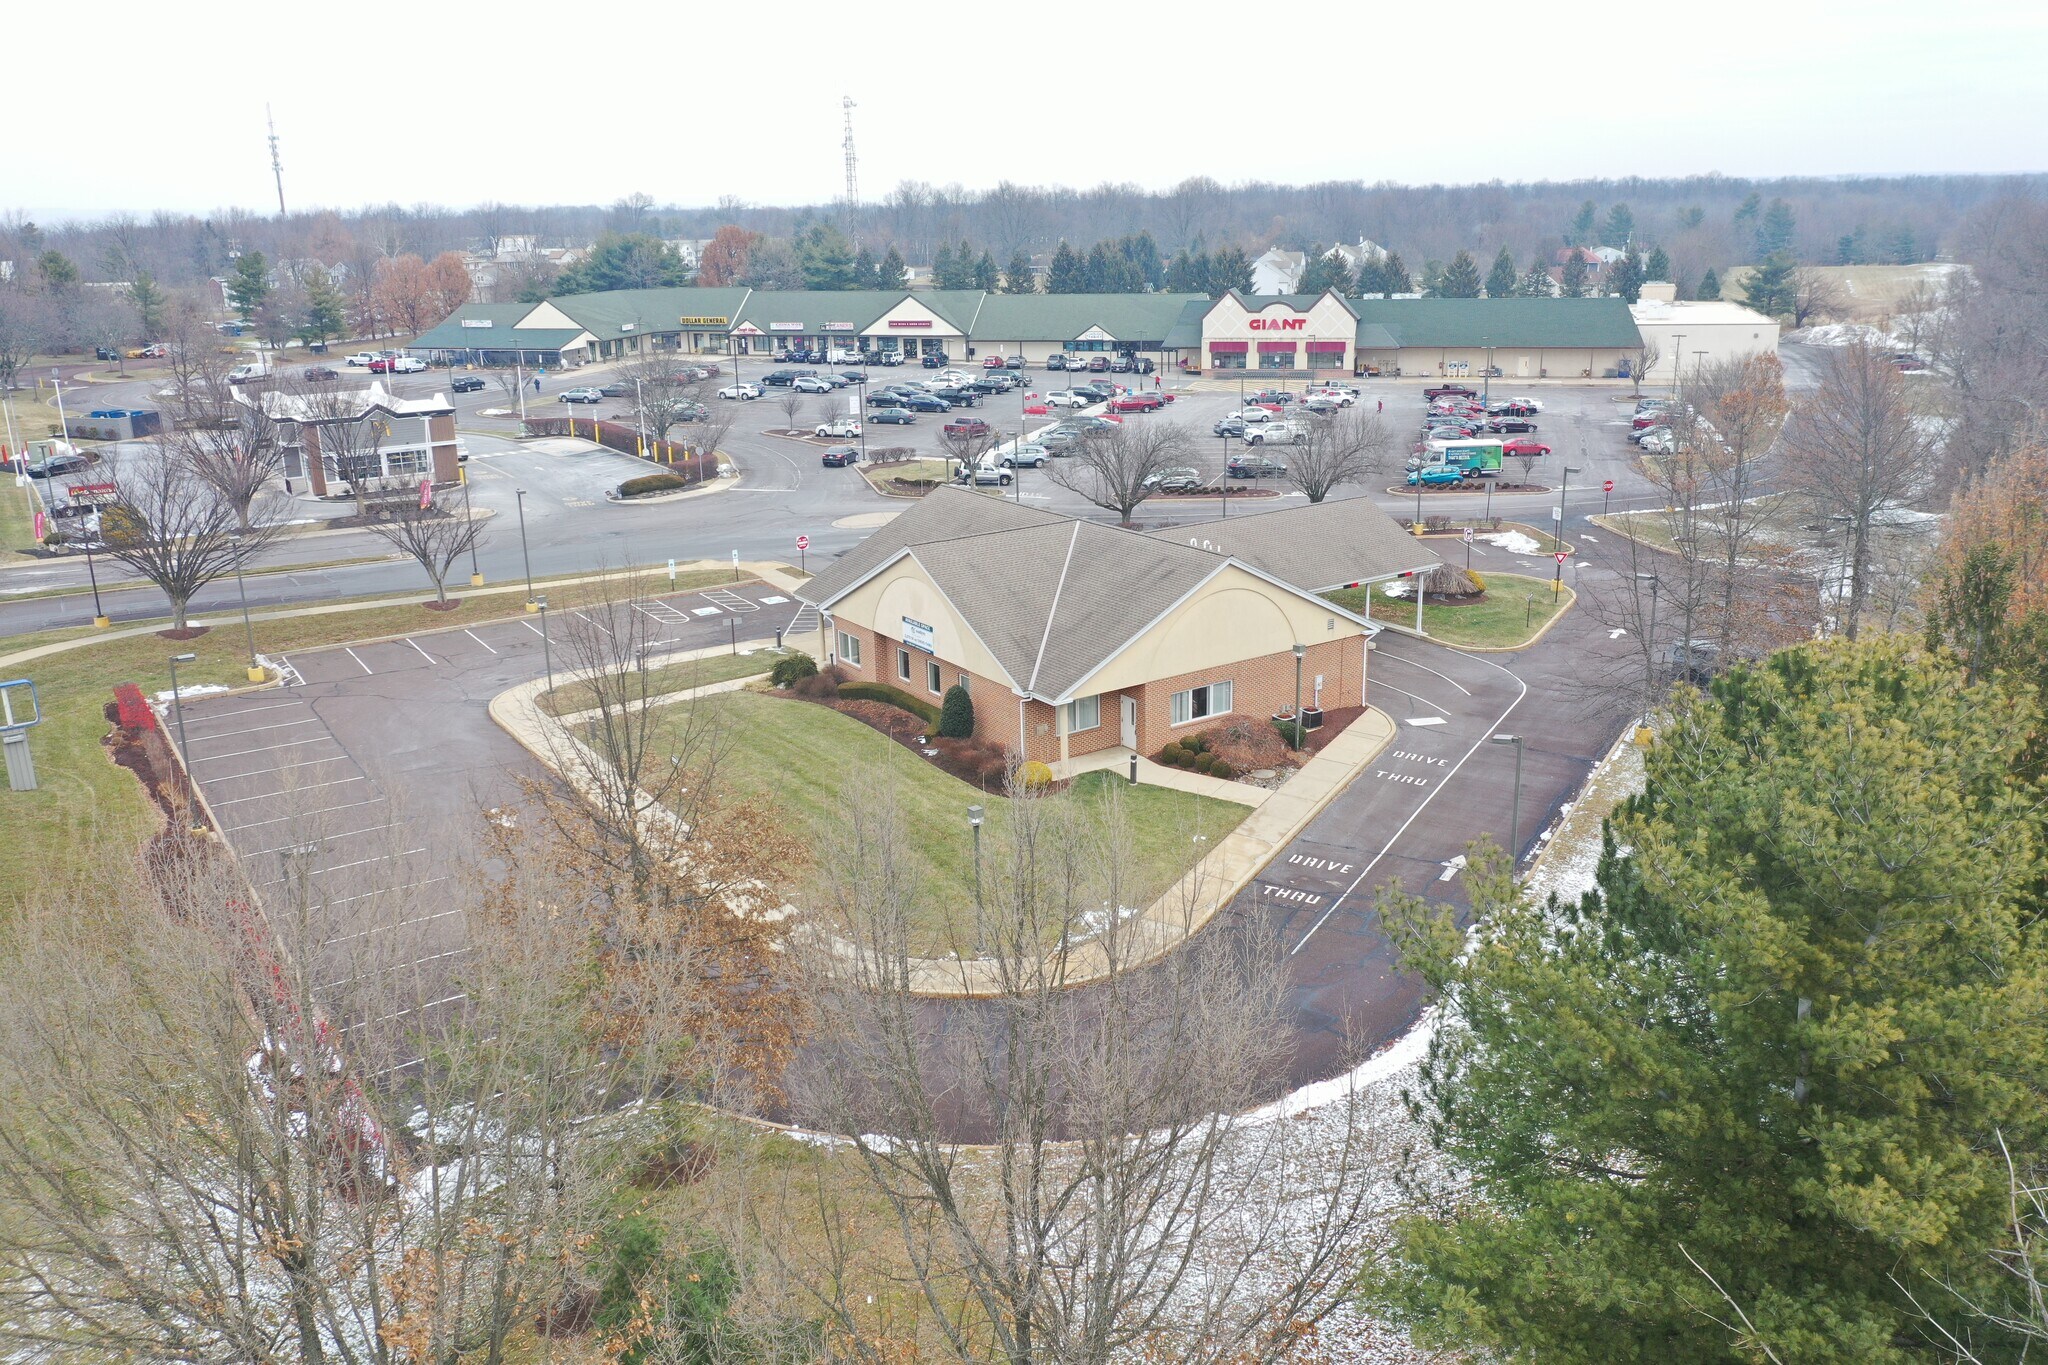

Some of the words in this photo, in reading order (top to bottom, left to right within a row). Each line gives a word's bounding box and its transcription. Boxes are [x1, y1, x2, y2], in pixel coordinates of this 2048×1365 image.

[1249, 318, 1307, 331] GIANT
[1392, 750, 1450, 767] DRIVE
[1377, 770, 1428, 786] THRU
[1288, 854, 1354, 874] DRIVE
[1263, 885, 1322, 904] THRU
